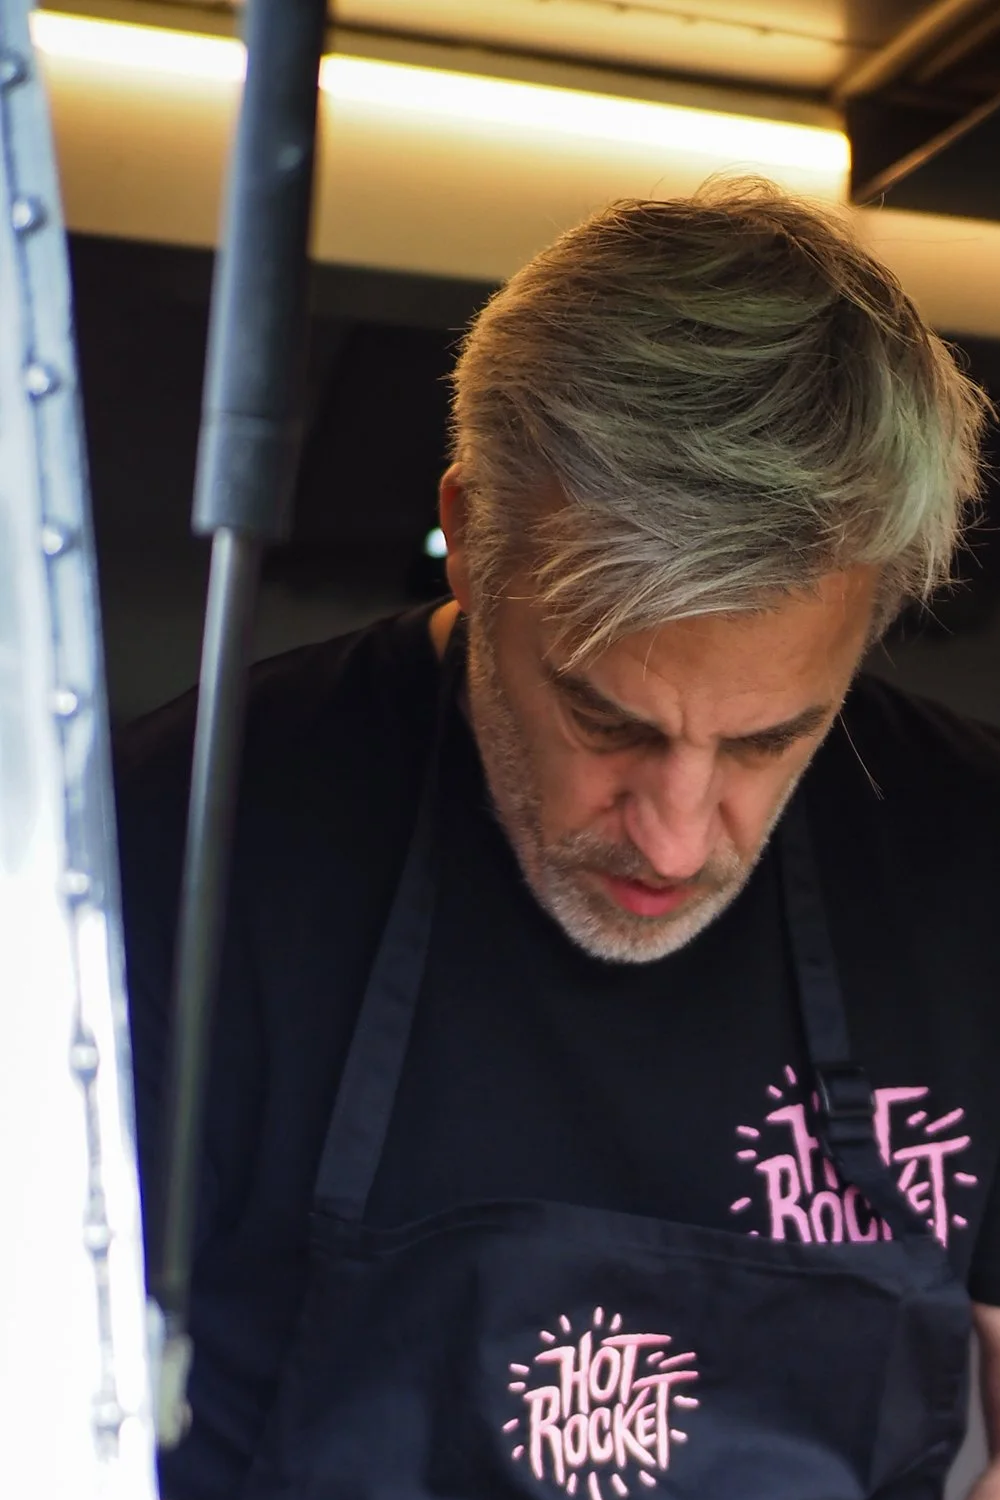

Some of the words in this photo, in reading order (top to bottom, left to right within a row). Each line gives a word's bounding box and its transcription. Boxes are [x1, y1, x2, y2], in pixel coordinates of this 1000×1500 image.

[766, 1086, 929, 1195] HT
[523, 1371, 699, 1484] ROCKET
[535, 1331, 672, 1418] HOT
